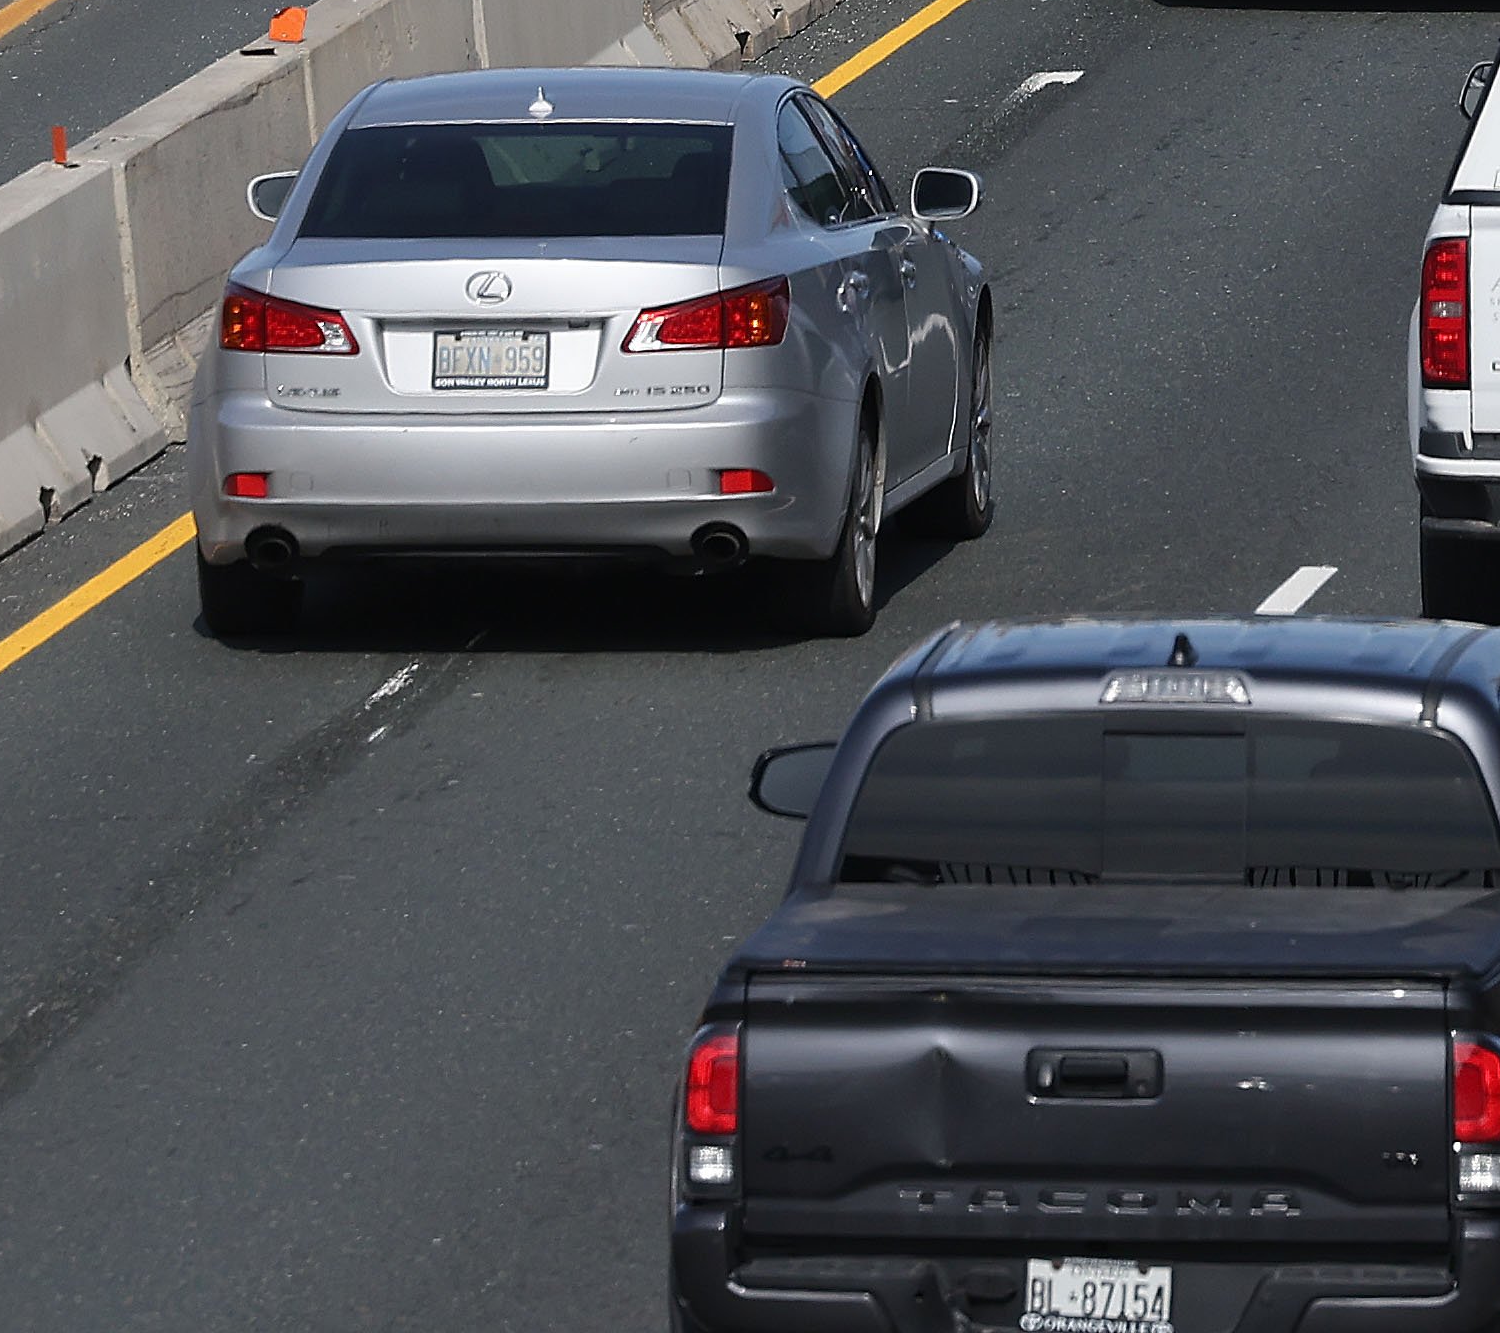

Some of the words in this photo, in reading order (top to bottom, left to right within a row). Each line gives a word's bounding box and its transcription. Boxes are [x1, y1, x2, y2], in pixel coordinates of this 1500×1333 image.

[899, 1187, 1301, 1217] TACOMA
[1082, 1280, 1165, 1320] 87154
[1043, 1314, 1150, 1333] ORANGEVILLE
